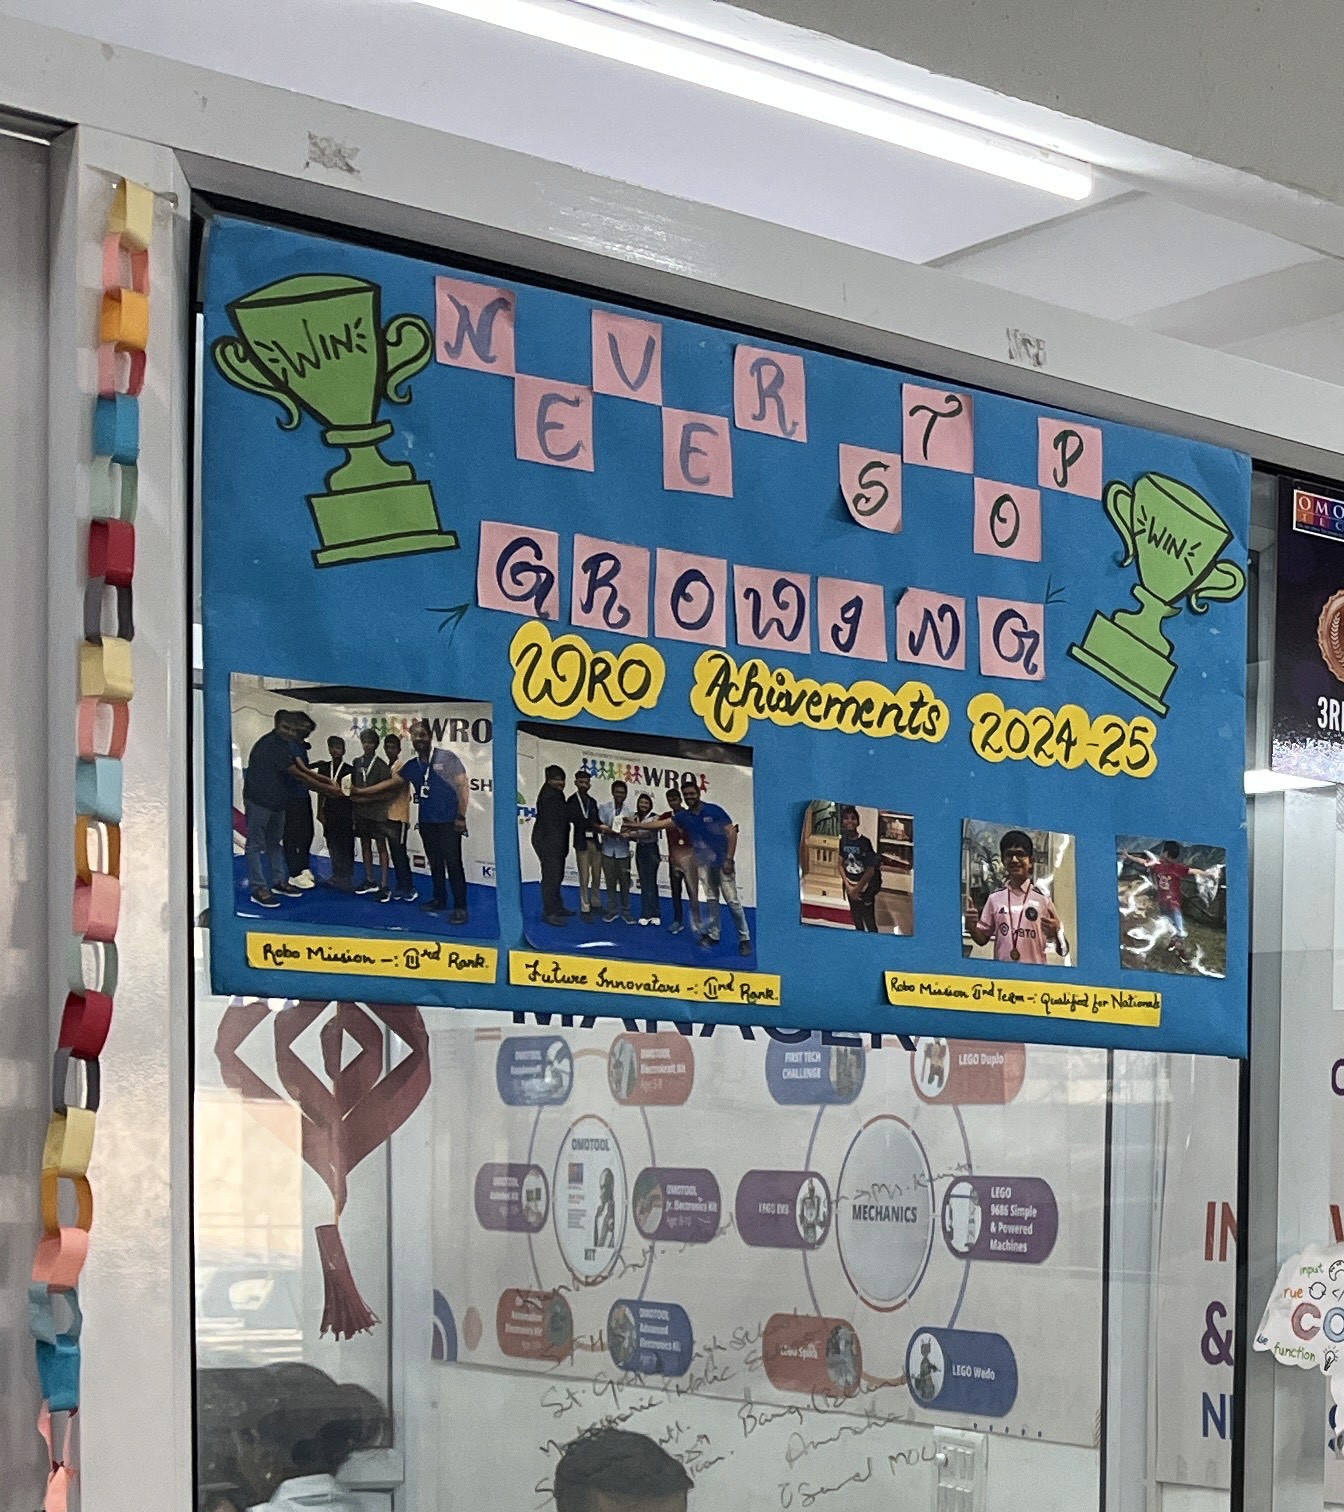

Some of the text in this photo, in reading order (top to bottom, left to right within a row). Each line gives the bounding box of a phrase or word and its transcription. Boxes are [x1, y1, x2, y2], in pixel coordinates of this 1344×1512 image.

[273, 318, 353, 378] WIN
[1148, 514, 1187, 561] WIN
[497, 536, 1039, 676] GROWING
[516, 643, 652, 708] WRO
[979, 710, 1151, 771] 2024-25
[263, 943, 375, 966] Robo Mission
[526, 960, 588, 984] Future
[891, 977, 915, 993] Robo
[959, 1053, 979, 1066] LEGO
[991, 1186, 1012, 1199] LEGO
[851, 1204, 918, 1224] MECHANICS
[1010, 1204, 1037, 1219] Simple
[998, 1222, 1033, 1235] Powered
[990, 1238, 1028, 1253] Machines
[1274, 1342, 1317, 1363] function
[952, 1365, 971, 1378] LEGO
